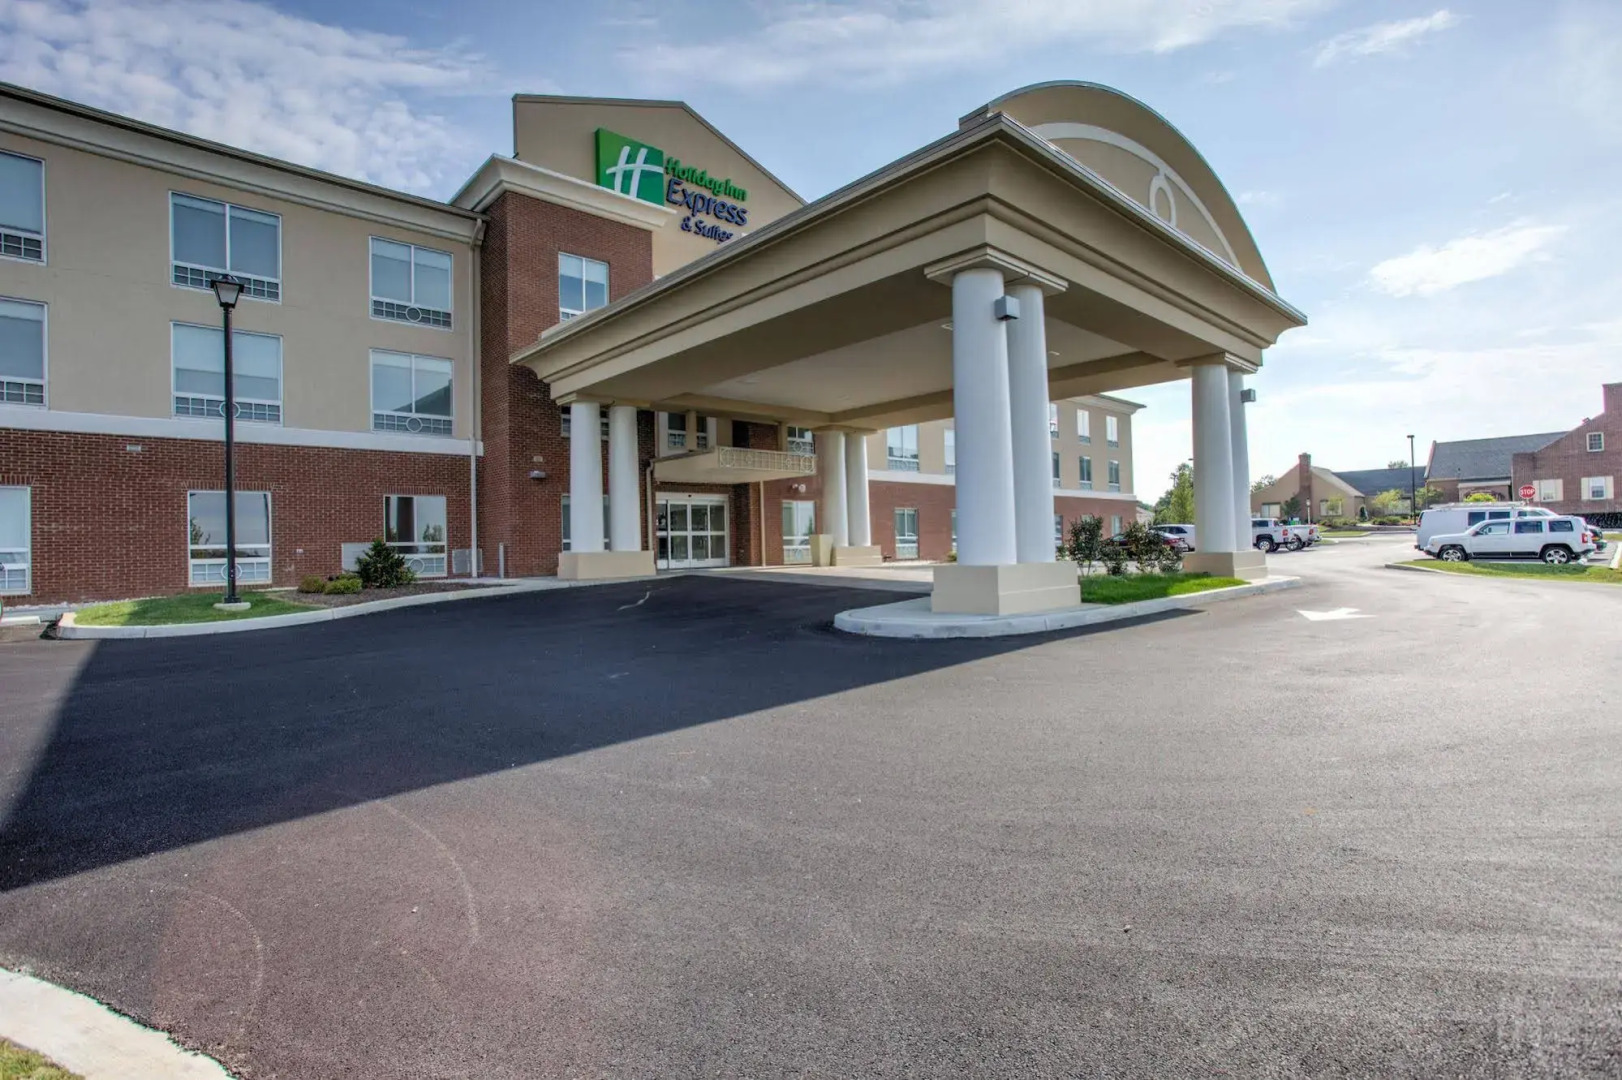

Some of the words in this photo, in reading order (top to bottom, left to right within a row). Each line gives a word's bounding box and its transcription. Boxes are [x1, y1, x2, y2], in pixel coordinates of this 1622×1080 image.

[665, 157, 724, 196] Holiday
[723, 178, 747, 201] Inn
[666, 177, 748, 226] Express
[681, 216, 692, 232] &
